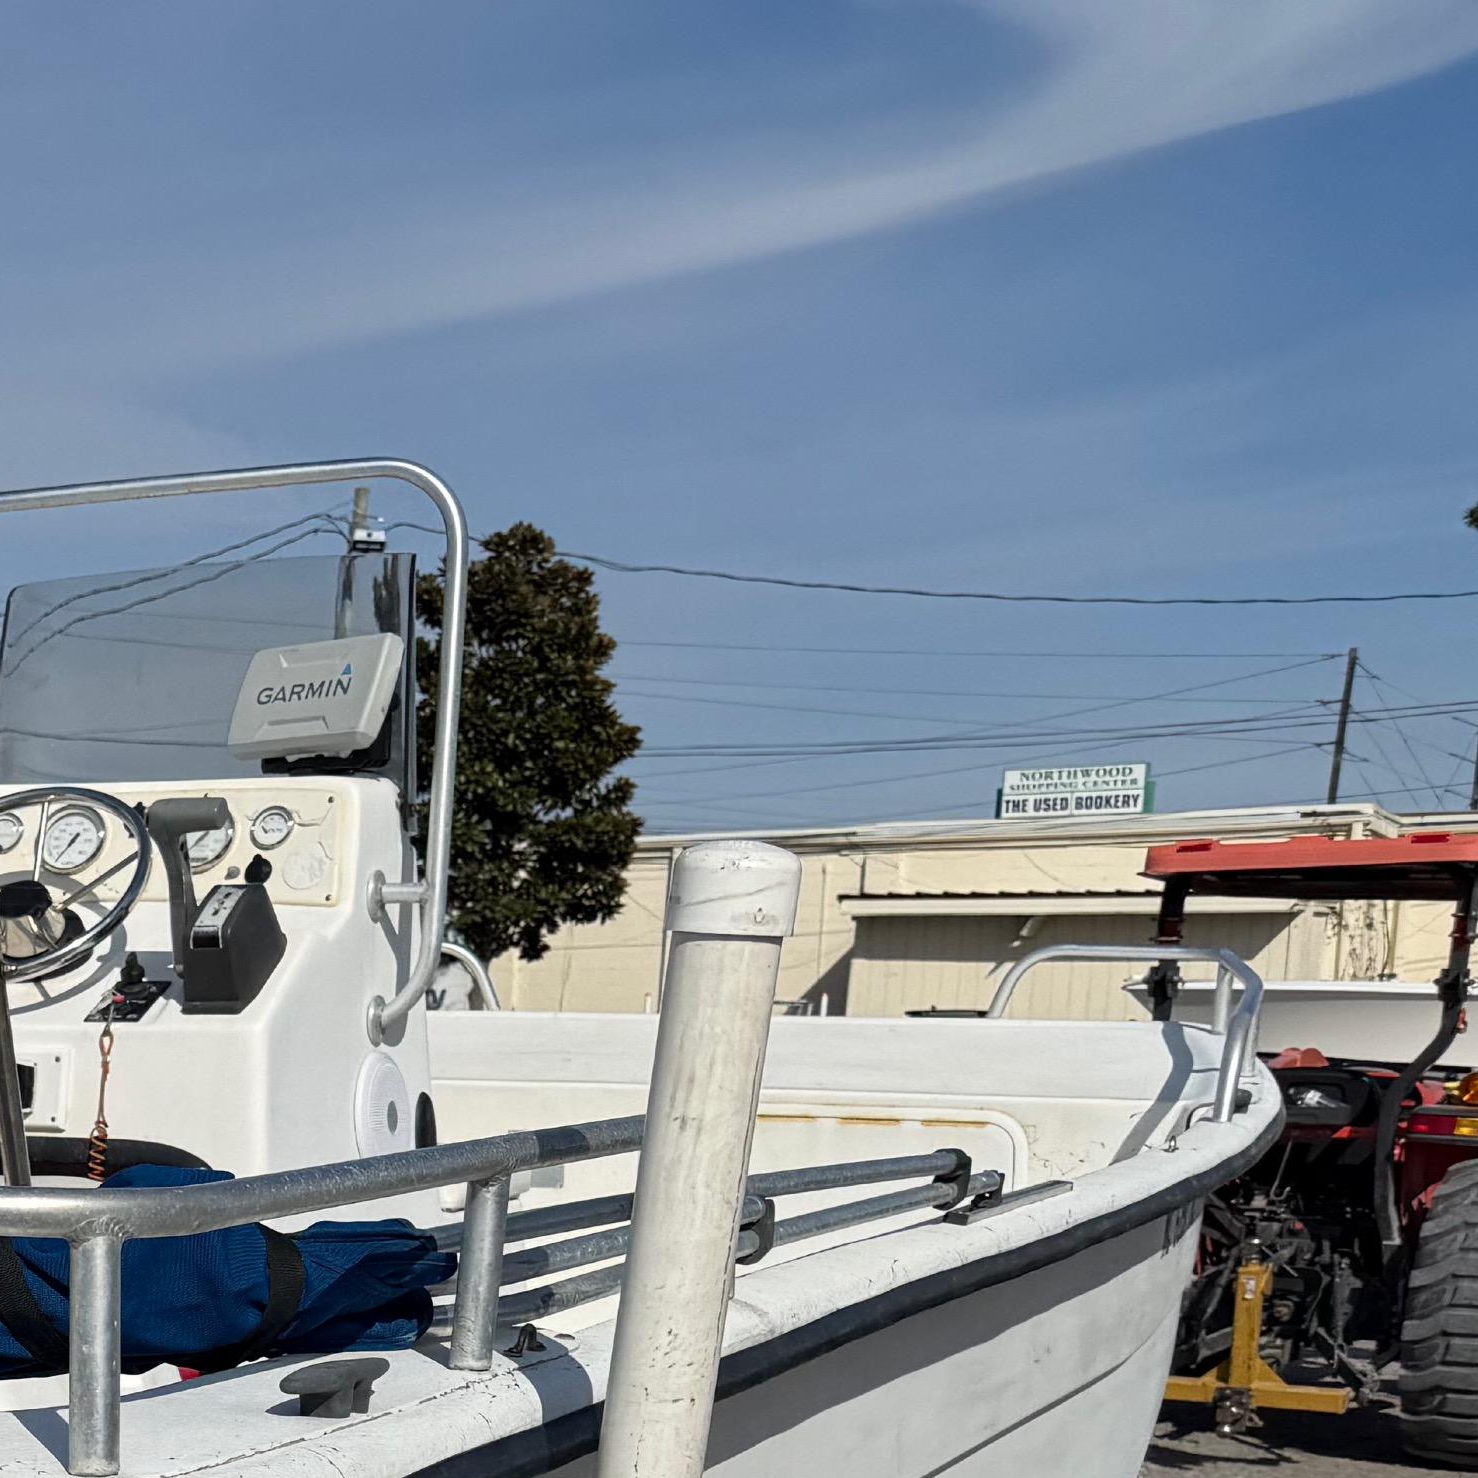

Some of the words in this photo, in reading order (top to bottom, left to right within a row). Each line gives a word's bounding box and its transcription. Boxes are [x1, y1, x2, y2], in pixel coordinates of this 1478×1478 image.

[257, 677, 352, 706] GARMIN
[1019, 766, 1133, 782] NORTHWOOD
[1009, 782, 1079, 791] SHOPPING
[1082, 778, 1138, 788] CENTER
[1004, 799, 1028, 813] THE
[1033, 797, 1069, 812] USED
[1074, 794, 1140, 811] BOOKERY
